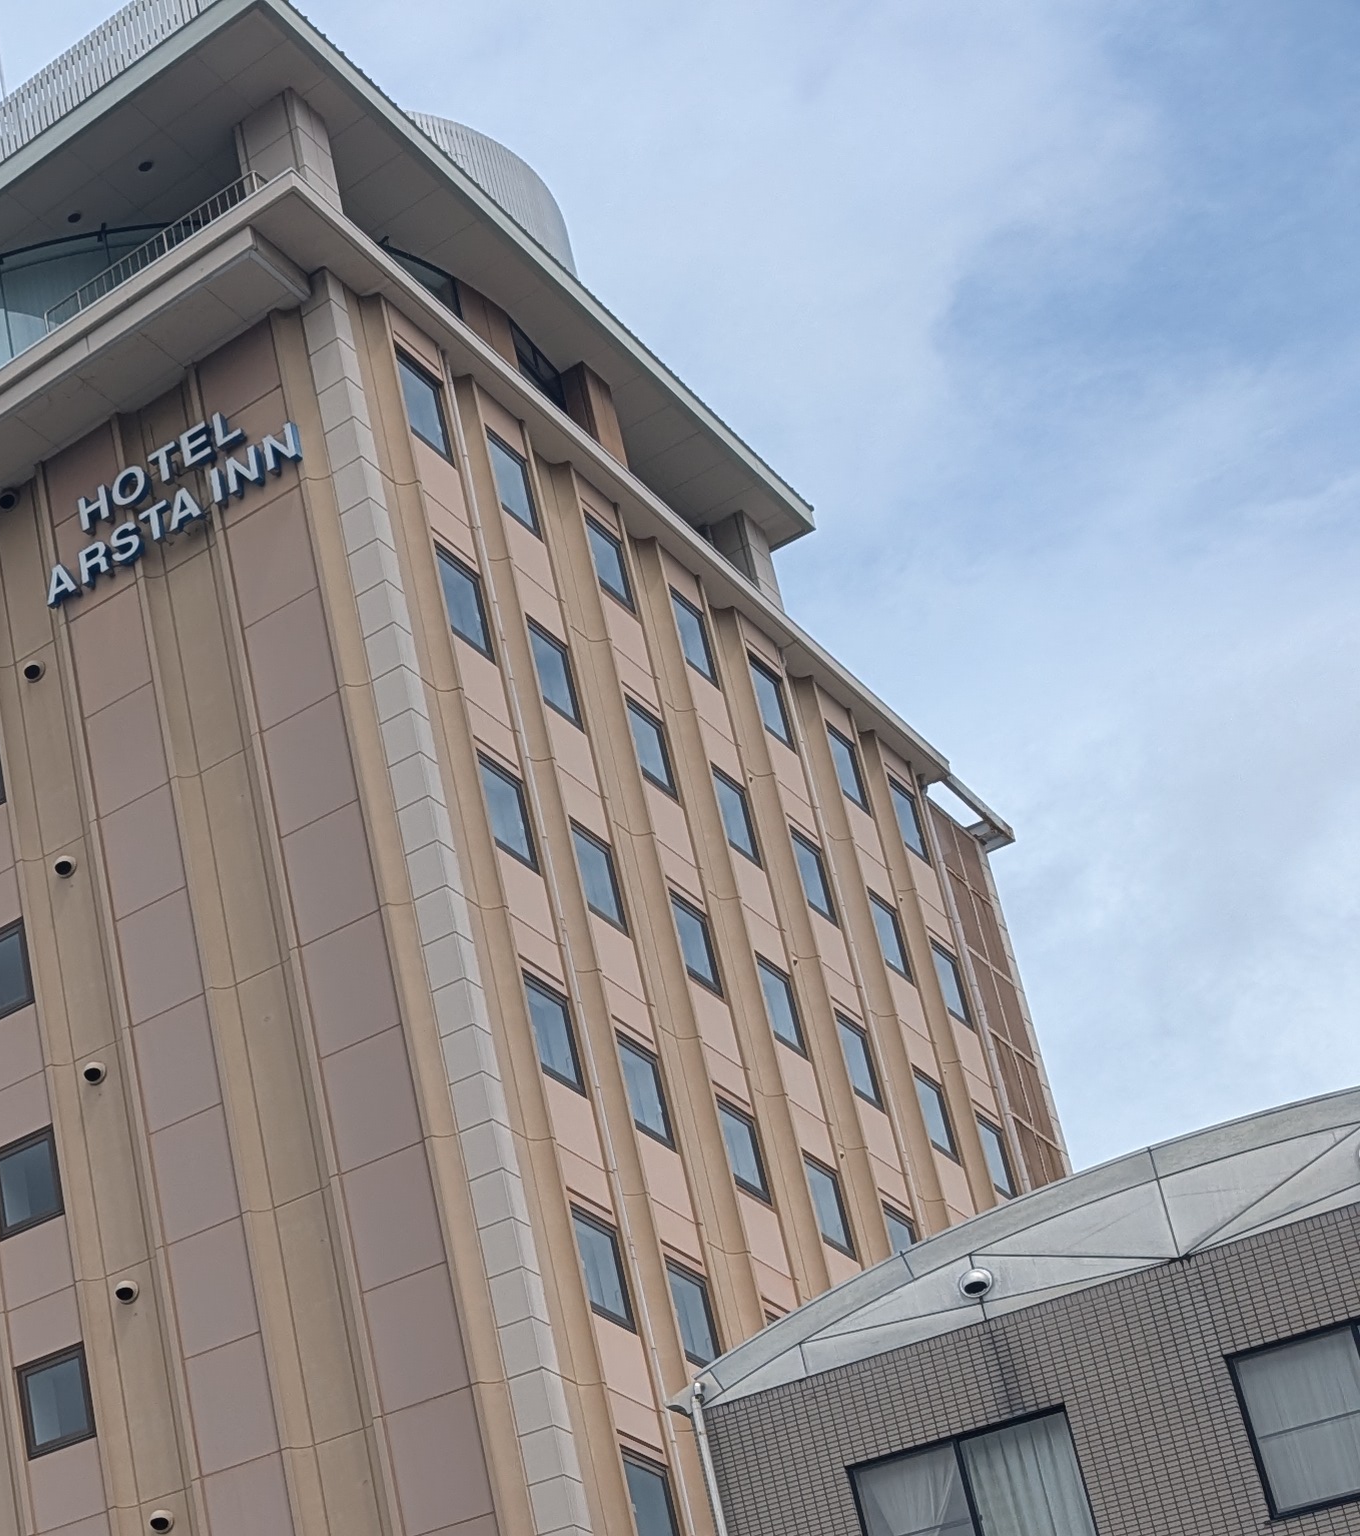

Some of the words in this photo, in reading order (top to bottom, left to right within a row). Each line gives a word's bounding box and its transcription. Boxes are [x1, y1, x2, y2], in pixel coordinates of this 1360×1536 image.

[47, 487, 207, 609] ARSTA
[210, 421, 303, 506] INN
[77, 411, 247, 536] HOTEL
